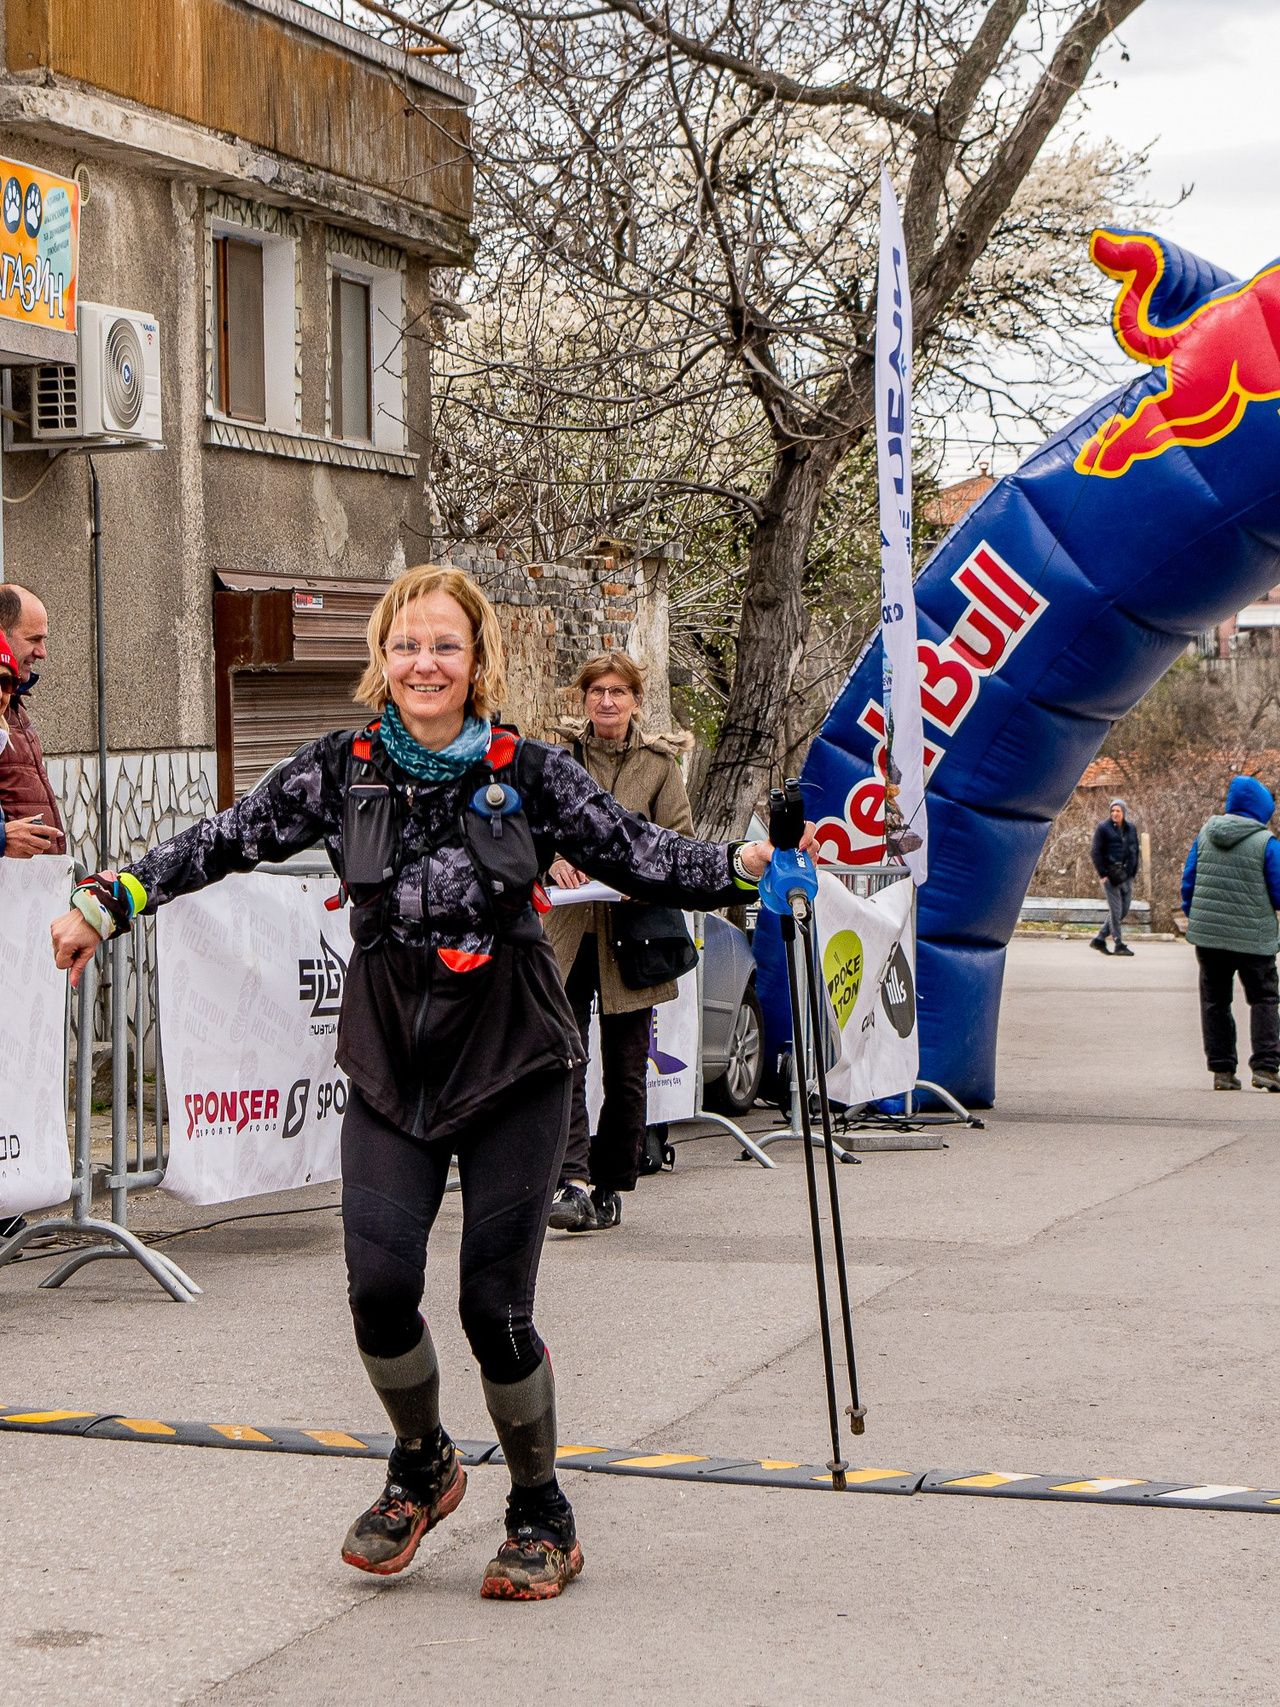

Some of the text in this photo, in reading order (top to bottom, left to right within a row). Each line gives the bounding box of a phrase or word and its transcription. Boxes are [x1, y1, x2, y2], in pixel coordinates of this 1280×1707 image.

[917, 543, 1045, 733] Bull
[185, 1088, 280, 1140] SPONSER
[249, 1122, 277, 1133] FOOD
